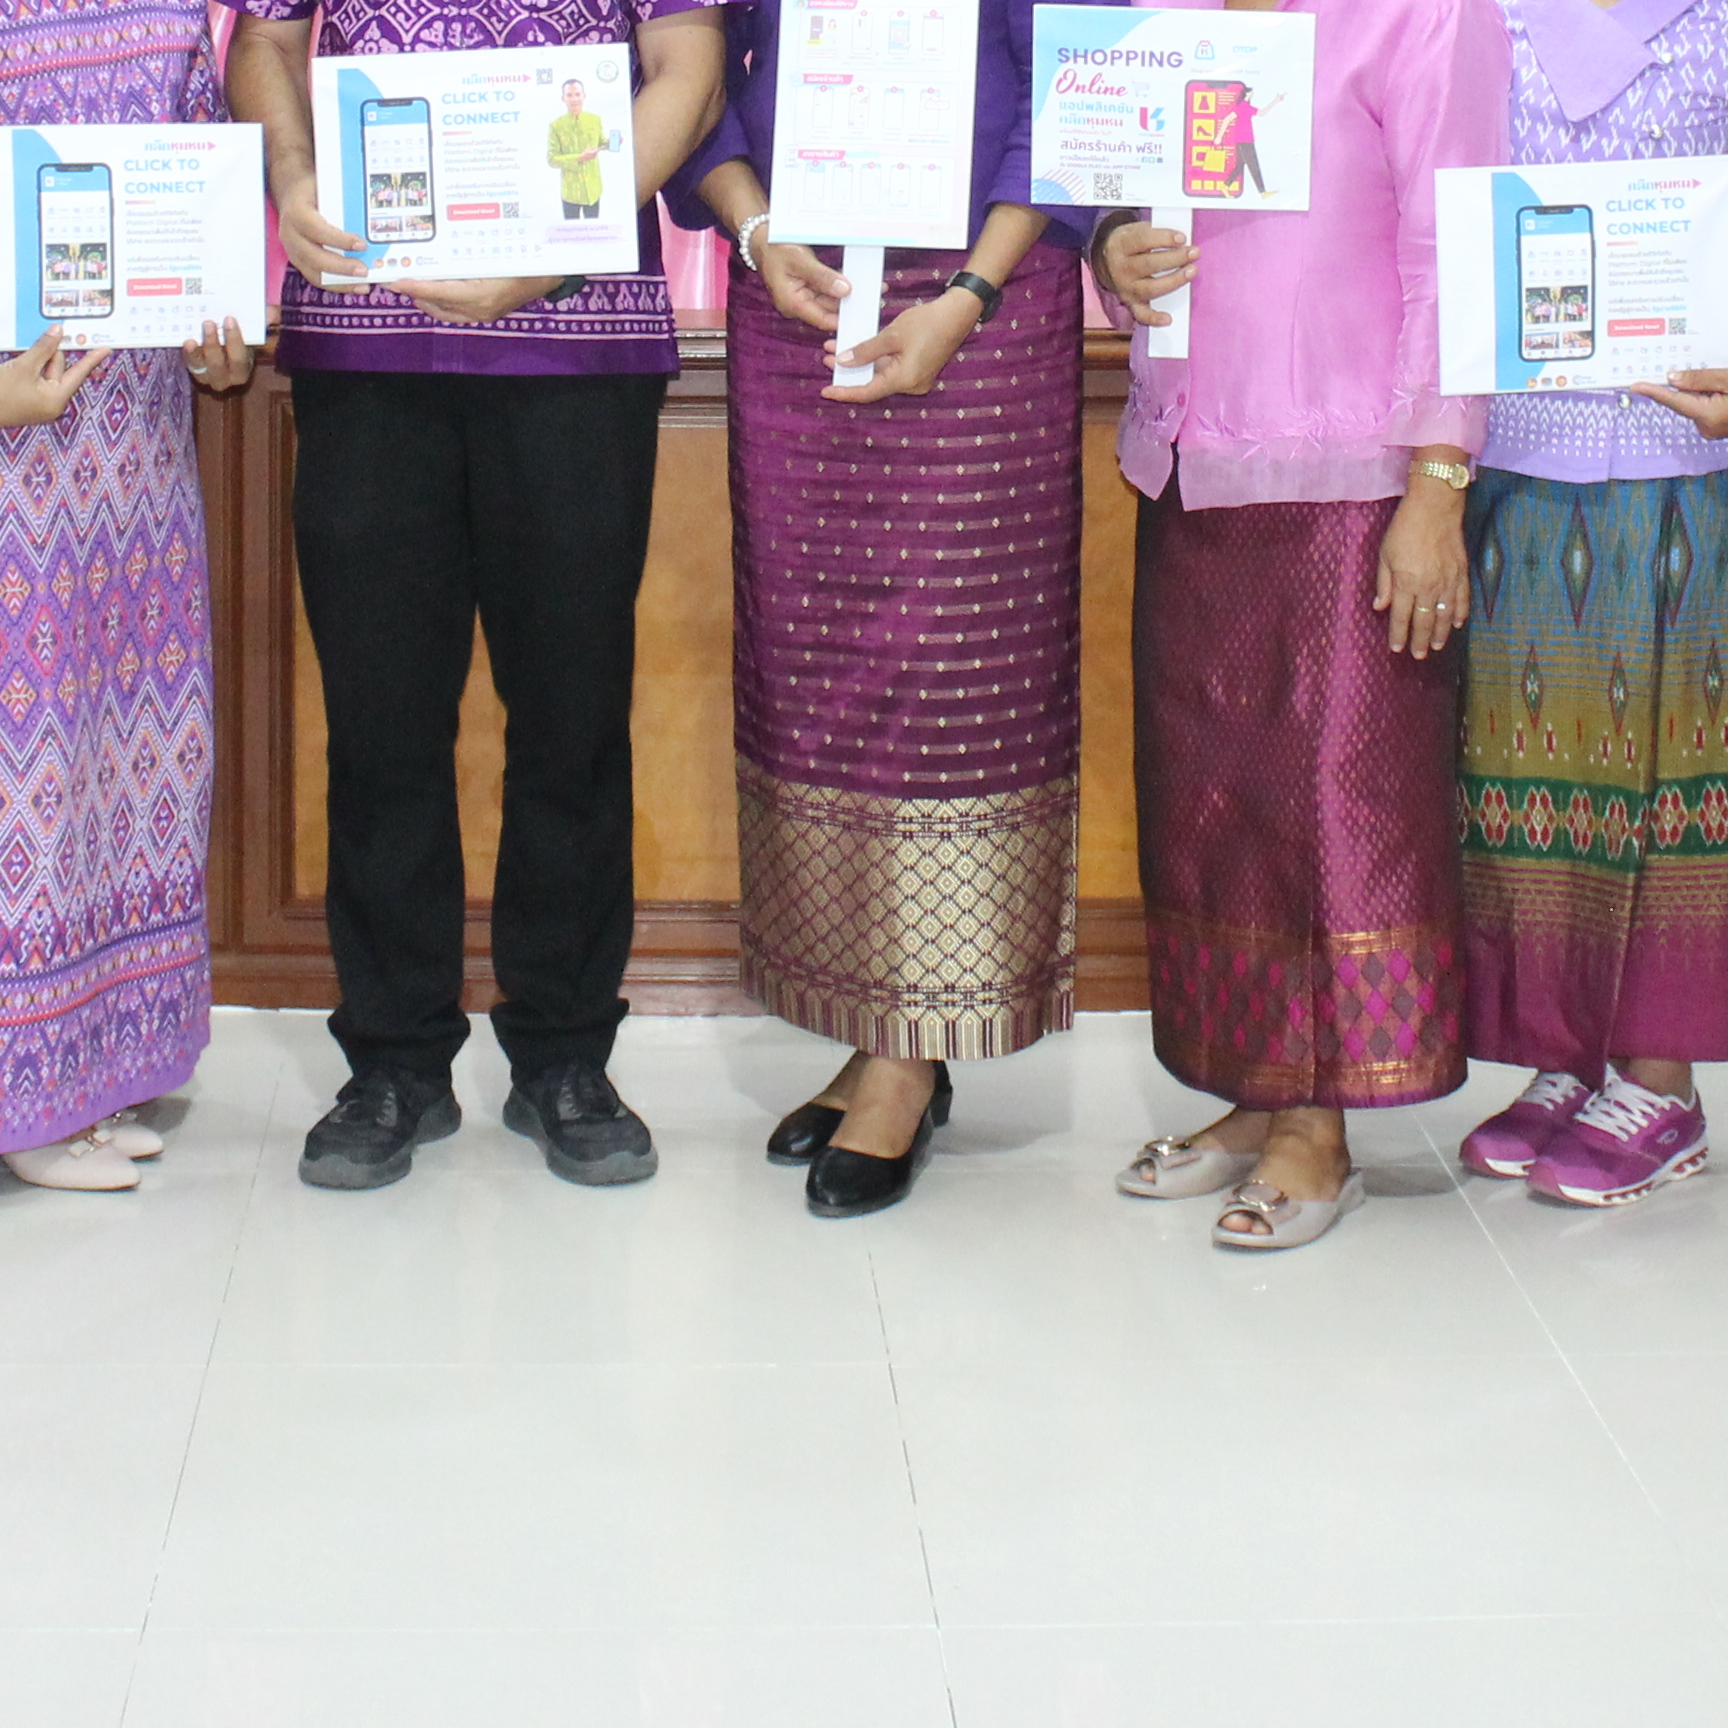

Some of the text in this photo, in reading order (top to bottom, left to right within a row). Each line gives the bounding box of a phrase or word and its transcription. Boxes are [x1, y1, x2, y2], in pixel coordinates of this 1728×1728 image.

[1056, 47, 1184, 69] SHOPPING
[1055, 68, 1129, 98] Online
[441, 90, 516, 105] CLICK TO
[442, 110, 521, 127] CONNECT
[1060, 138, 1163, 155] สมัครร้านค้า ฟรี!!
[123, 158, 200, 172] CLICK TO
[124, 180, 206, 194] CONNECT
[1605, 197, 1686, 213] CLICK TO
[1606, 219, 1692, 236] CONNECT
